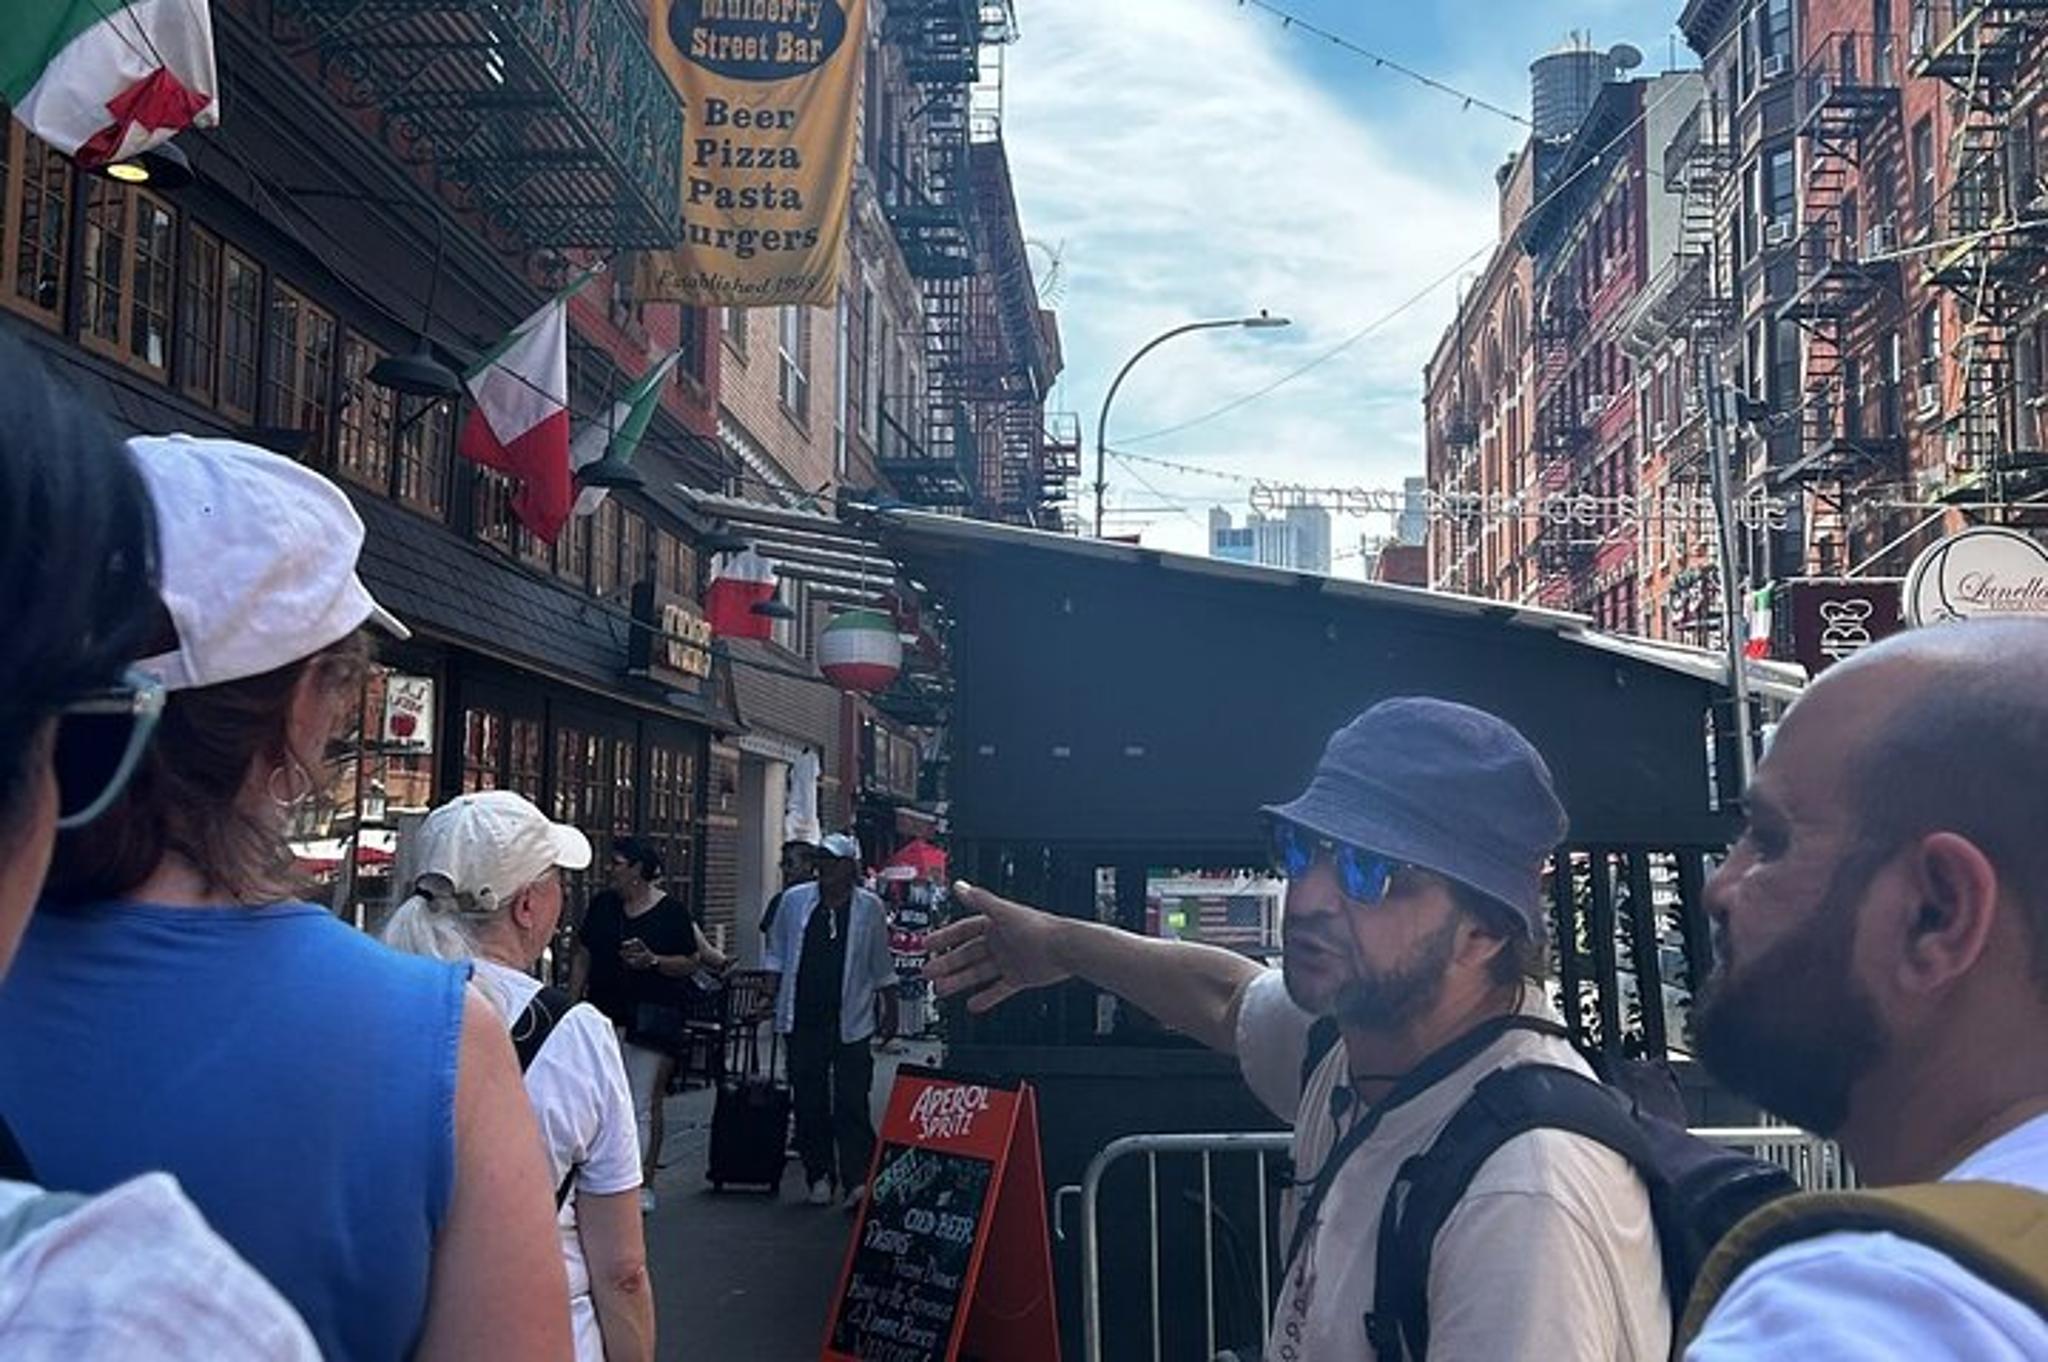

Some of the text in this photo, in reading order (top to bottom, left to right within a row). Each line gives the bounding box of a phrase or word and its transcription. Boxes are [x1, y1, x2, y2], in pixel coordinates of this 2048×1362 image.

[690, 27, 822, 63] Street Bar
[704, 98, 794, 128] Beer
[693, 138, 800, 169] Pizza
[687, 177, 802, 210] Pasta
[658, 270, 769, 294] Established
[909, 1085, 989, 1121] APEROL
